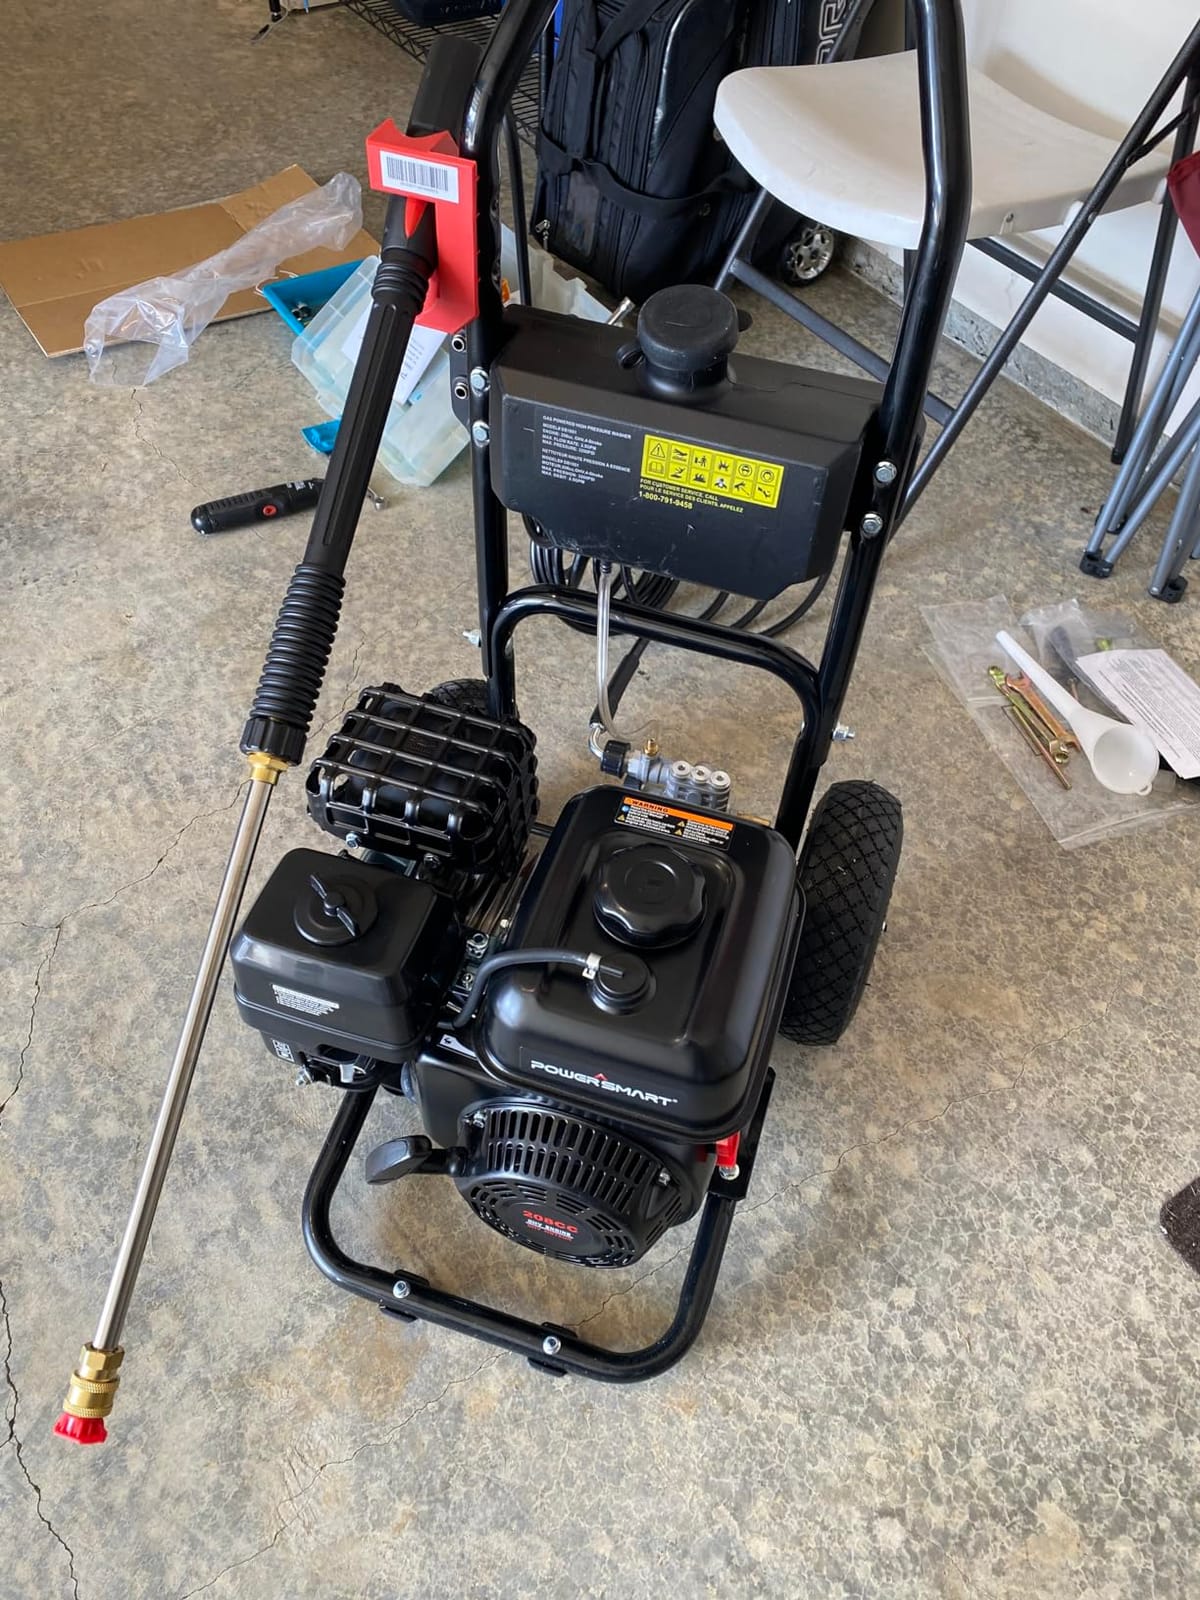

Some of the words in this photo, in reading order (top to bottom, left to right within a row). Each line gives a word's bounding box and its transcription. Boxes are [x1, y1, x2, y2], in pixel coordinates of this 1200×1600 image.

[553, 418, 575, 426] POWERED
[587, 425, 611, 435] PRESSURE
[612, 431, 631, 440] WASHER
[583, 457, 605, 466] PRESSION
[610, 463, 631, 473] ESSENCE
[640, 478, 652, 486] FOR
[652, 481, 680, 492] CUSTOMER
[662, 489, 684, 499] SERVICE
[719, 503, 744, 513] APPELEZ
[631, 800, 669, 813] WARNING
[522, 1210, 578, 1233] 208CC
